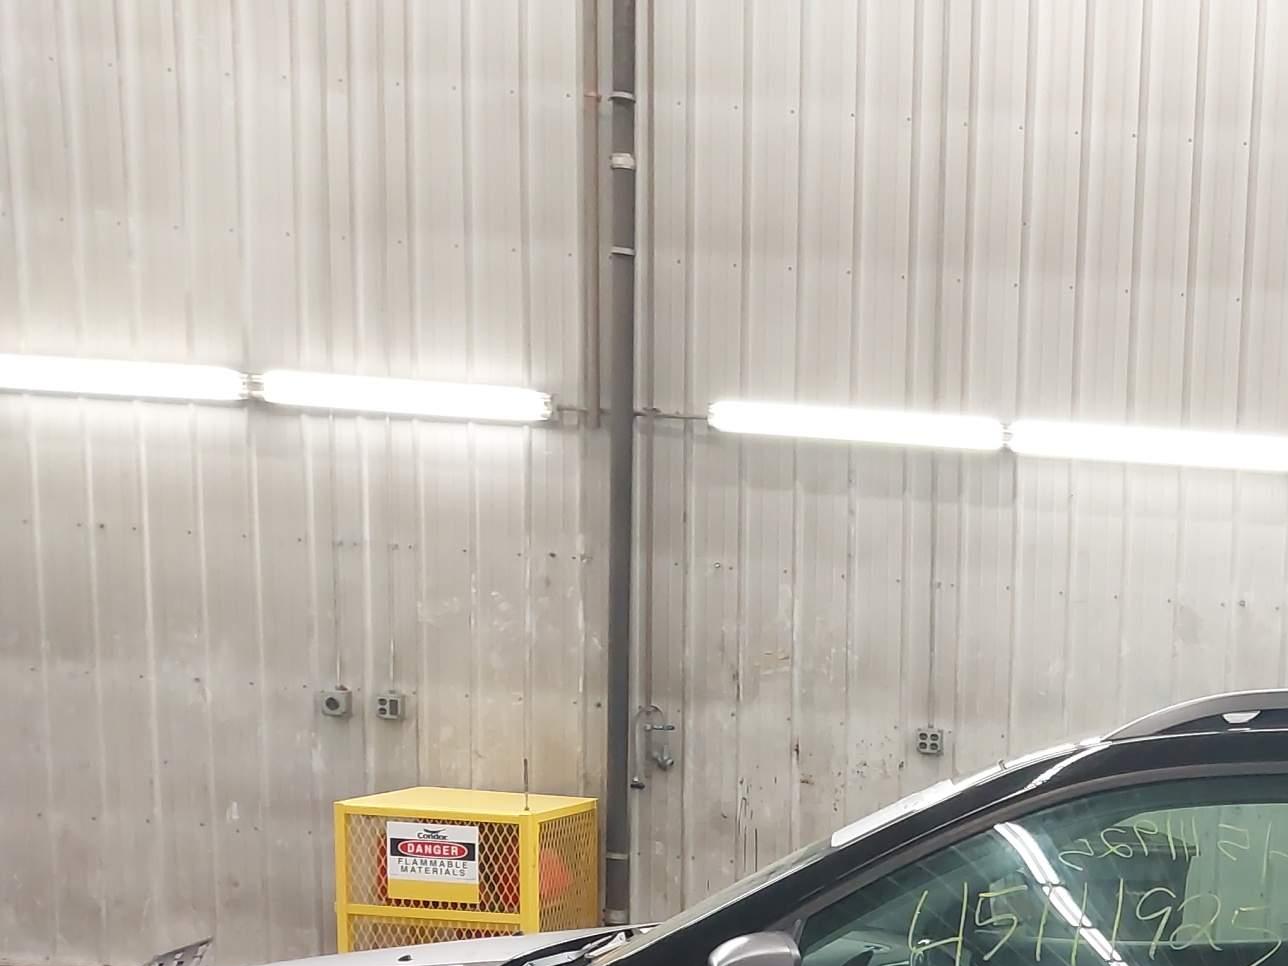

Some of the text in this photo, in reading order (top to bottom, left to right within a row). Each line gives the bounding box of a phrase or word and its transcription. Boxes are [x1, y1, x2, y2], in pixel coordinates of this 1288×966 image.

[417, 832, 448, 840] Condor
[407, 843, 459, 856] DANGER
[398, 858, 468, 869] FLAMMABLE
[400, 865, 466, 877] MATERIALS
